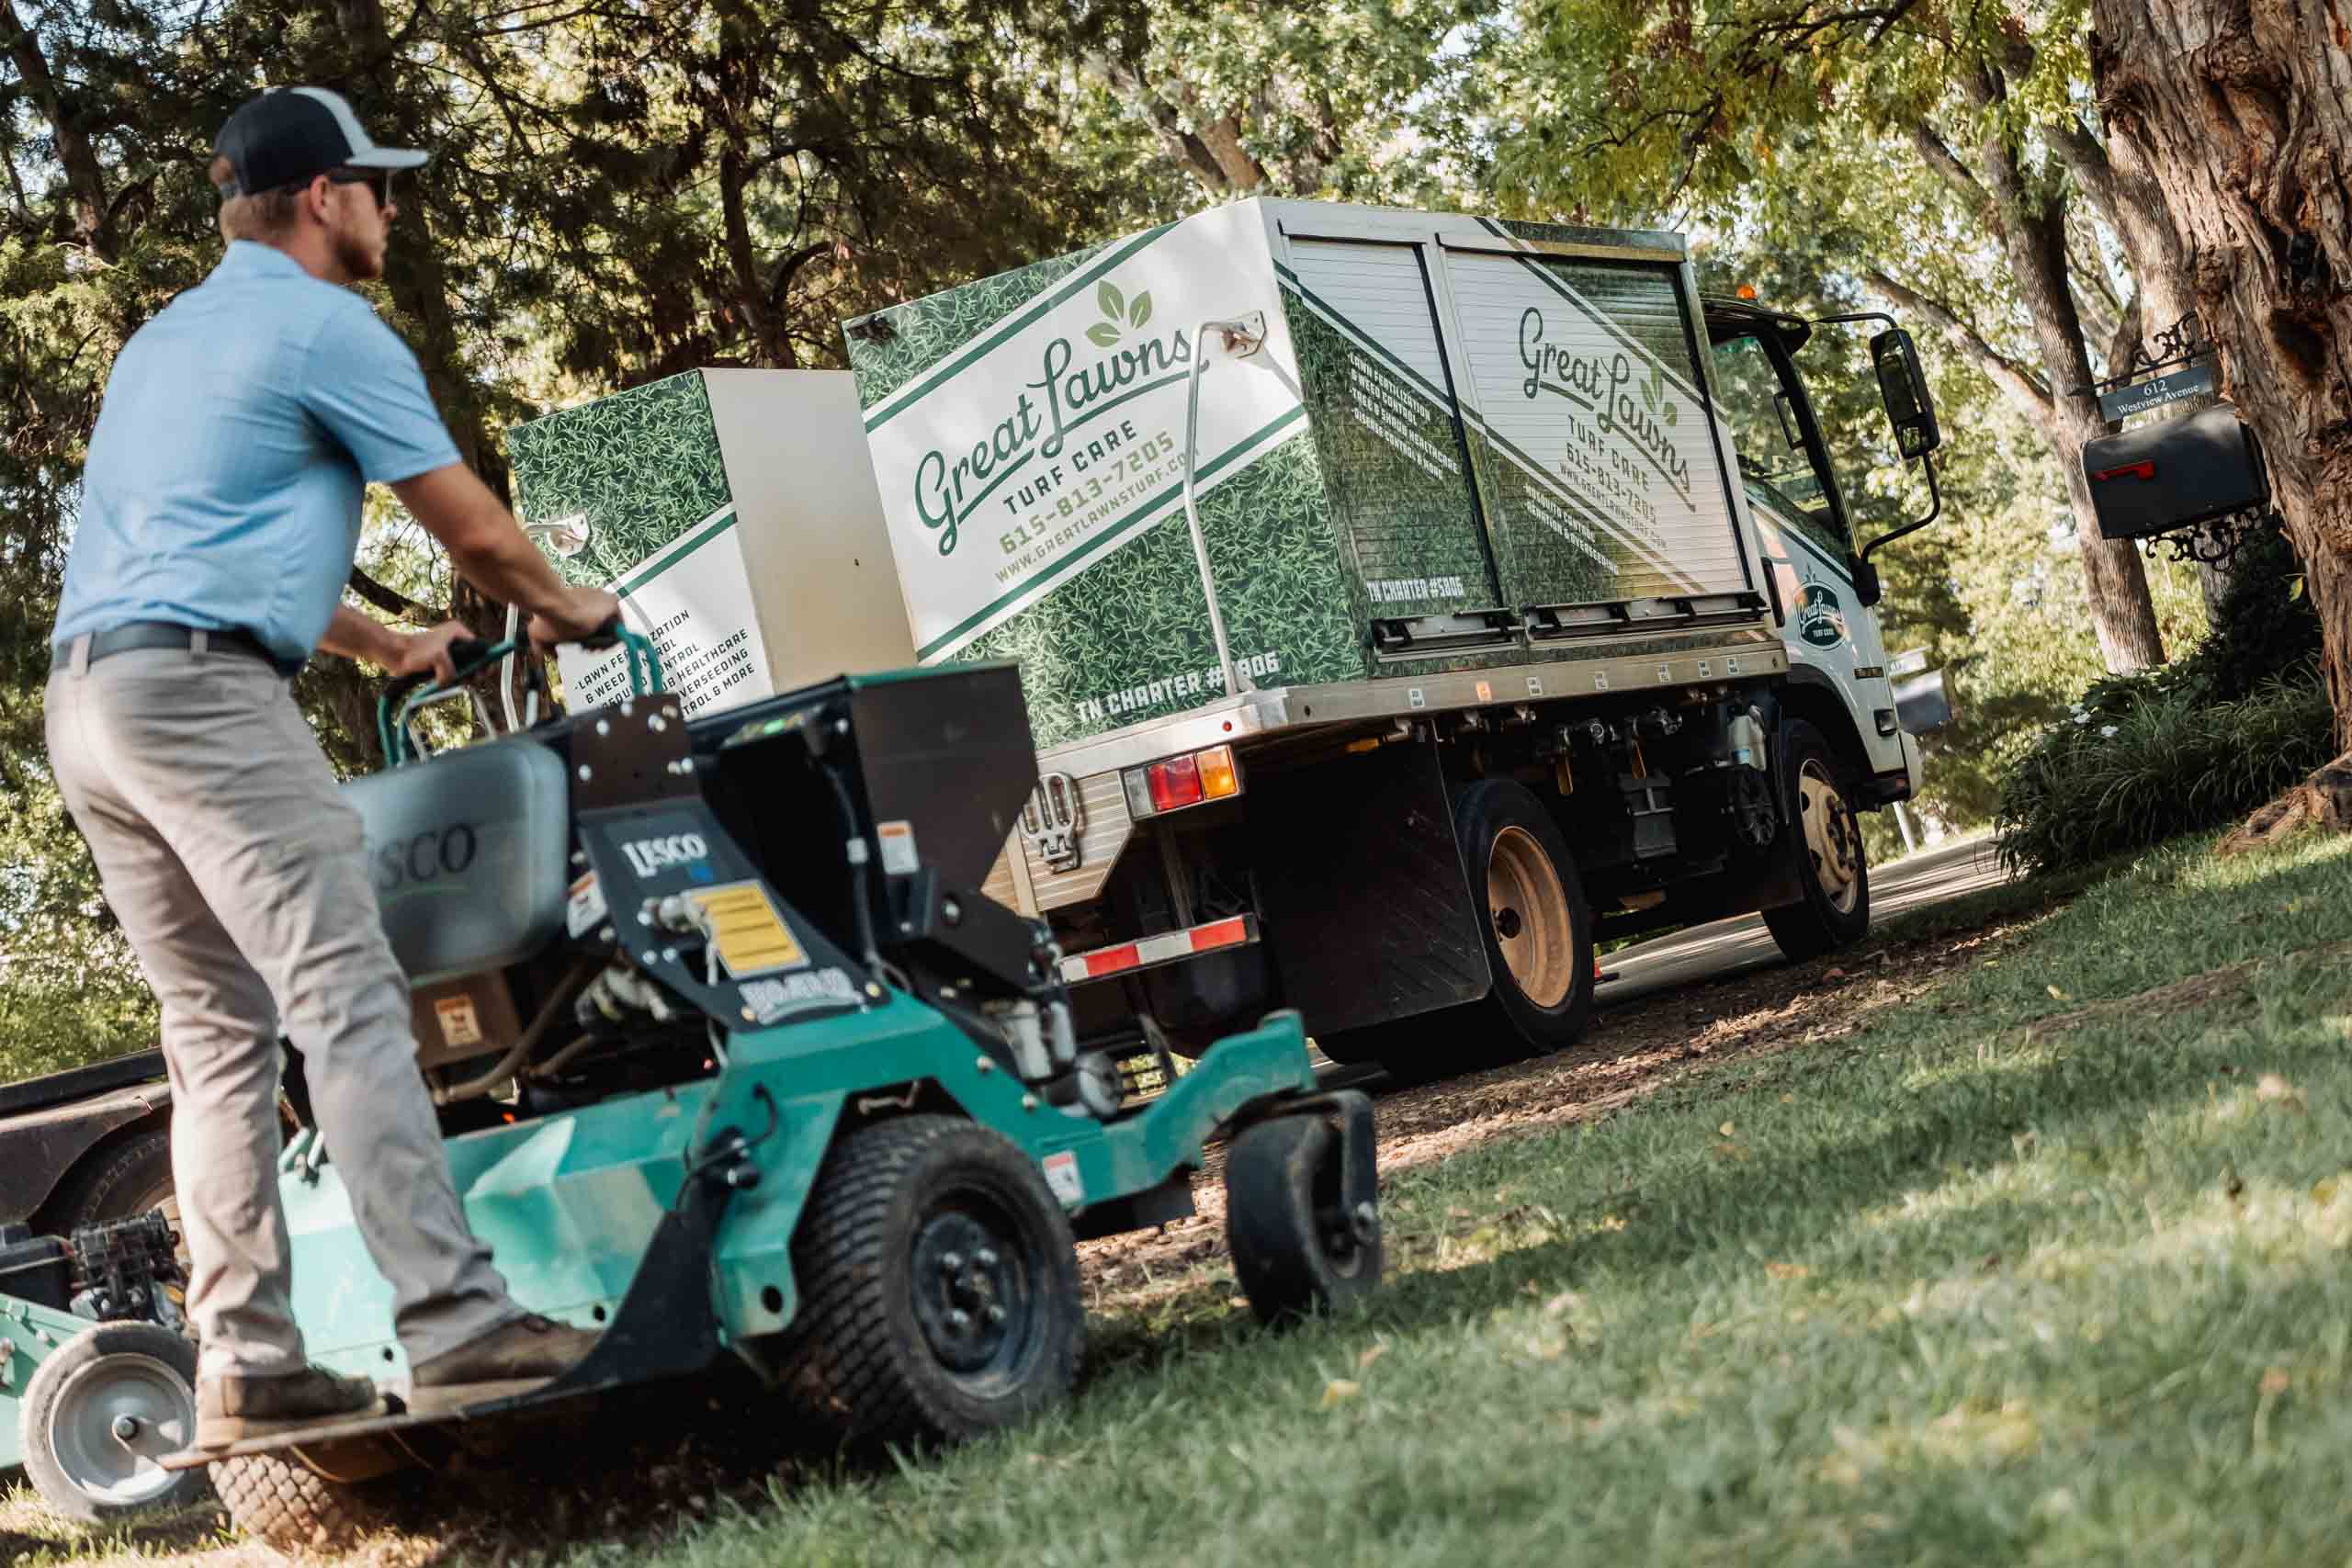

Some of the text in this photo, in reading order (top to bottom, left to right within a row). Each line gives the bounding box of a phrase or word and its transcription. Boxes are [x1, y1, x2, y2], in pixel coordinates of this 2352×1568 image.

[1359, 373, 1381, 399] WEED
[1382, 390, 1417, 426] CONTROL
[1374, 370, 1430, 422] FERTILIZATION
[1519, 307, 1691, 496] Great Lawns
[2118, 384, 2199, 414] Westview Avenue
[2143, 379, 2167, 396] 612
[915, 330, 1209, 556] Great Lawns
[1002, 420, 1137, 514] TURF CARE
[1408, 429, 1460, 474] HEALTHCARE
[1567, 413, 1650, 492] TURF CARE
[995, 448, 1200, 583] WWW.GREATLAWNSTURF.CO
[1000, 431, 1174, 555] 615-813-7205
[1382, 579, 1428, 602] CHARTER
[677, 628, 749, 682] HEALTHCARE
[679, 648, 749, 698] VERSEEDING
[722, 662, 755, 691] MORE
[594, 671, 627, 698] WEED
[1075, 650, 1280, 722] TN CHARTER #806
[621, 833, 708, 878] LESCO
